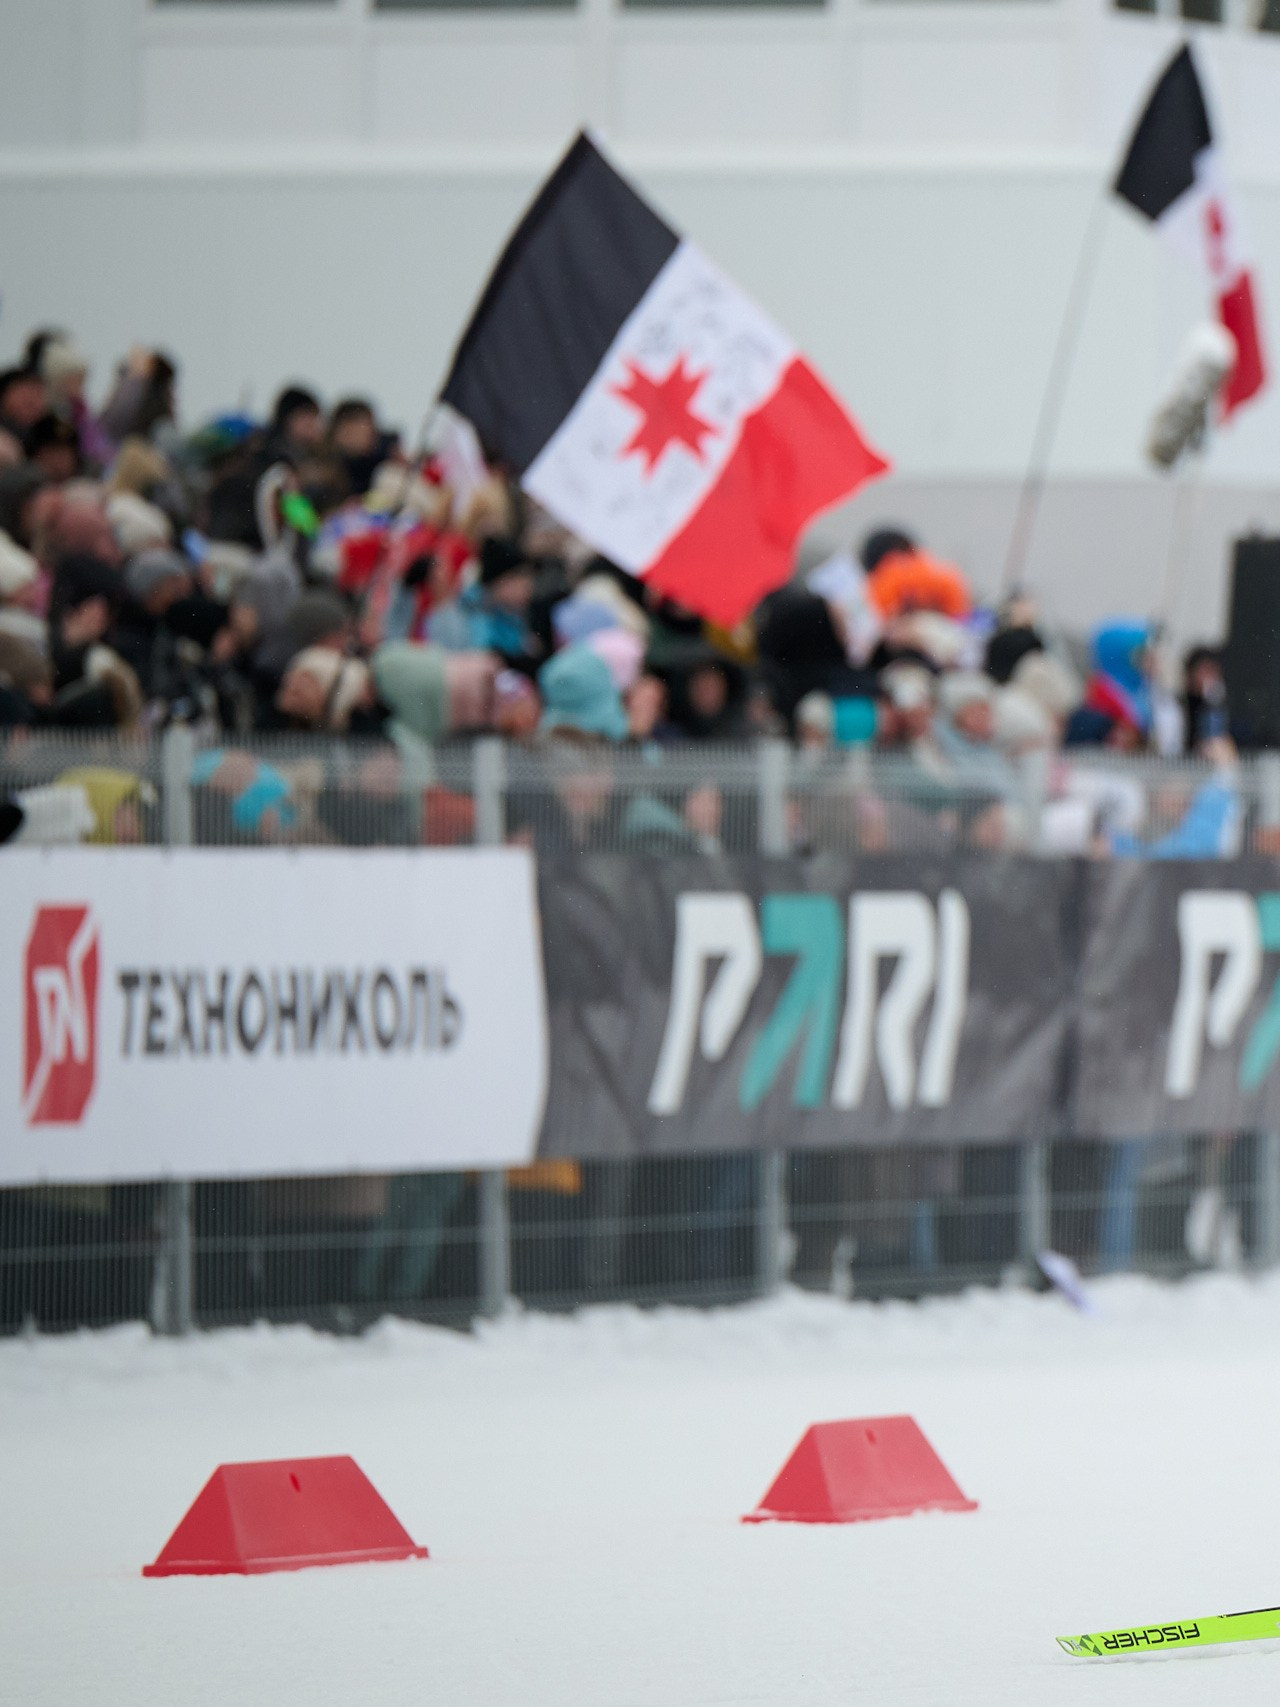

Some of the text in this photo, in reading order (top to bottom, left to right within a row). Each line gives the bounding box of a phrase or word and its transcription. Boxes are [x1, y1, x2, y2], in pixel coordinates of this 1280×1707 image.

[117, 967, 466, 1057] ТЕХНОНИКОЛЬ
[648, 890, 971, 1113] PARI
[1101, 1623, 1200, 1650] FISCHER
